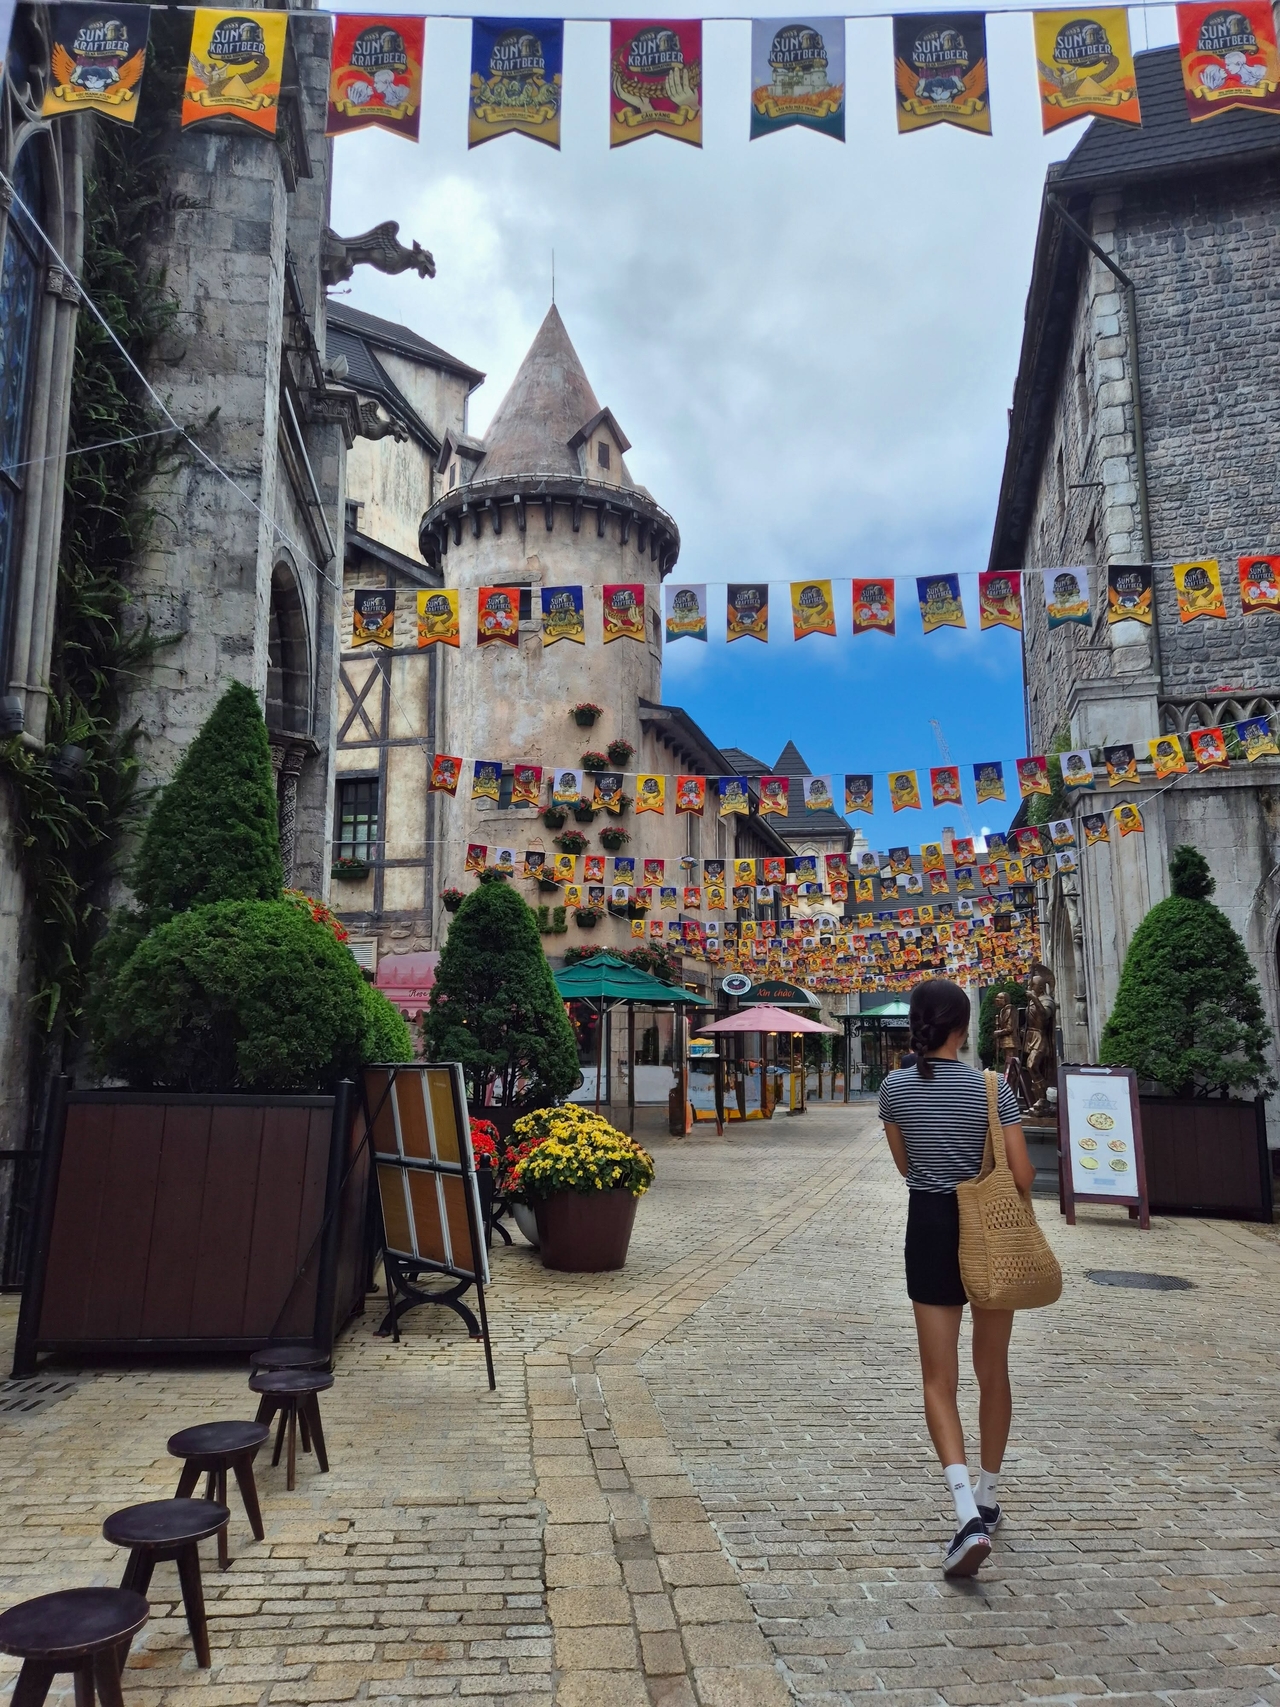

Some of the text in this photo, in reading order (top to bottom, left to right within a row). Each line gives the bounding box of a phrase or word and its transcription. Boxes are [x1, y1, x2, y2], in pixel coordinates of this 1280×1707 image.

[79, 28, 104, 42] SUN
[214, 28, 239, 42] SUN
[1201, 24, 1227, 38] SUN
[74, 40, 129, 52] KRAFTBEER
[355, 40, 380, 53] SUN
[631, 41, 657, 54] SUN
[774, 38, 799, 51] SUN
[915, 40, 940, 52] SUN
[1057, 35, 1082, 47] SUN
[1199, 35, 1255, 50] KRAFTBEER
[210, 42, 264, 54] KRAFTBEER
[494, 46, 519, 59] SUN
[1055, 45, 1110, 58] KRAFTBEER
[352, 52, 407, 64] KRAFTBEER
[629, 52, 684, 66] KRAFTBEER
[770, 49, 827, 62] KRAFTBEER
[912, 50, 968, 62] KRAFTBEER
[490, 57, 545, 70] KRAFTBEER
